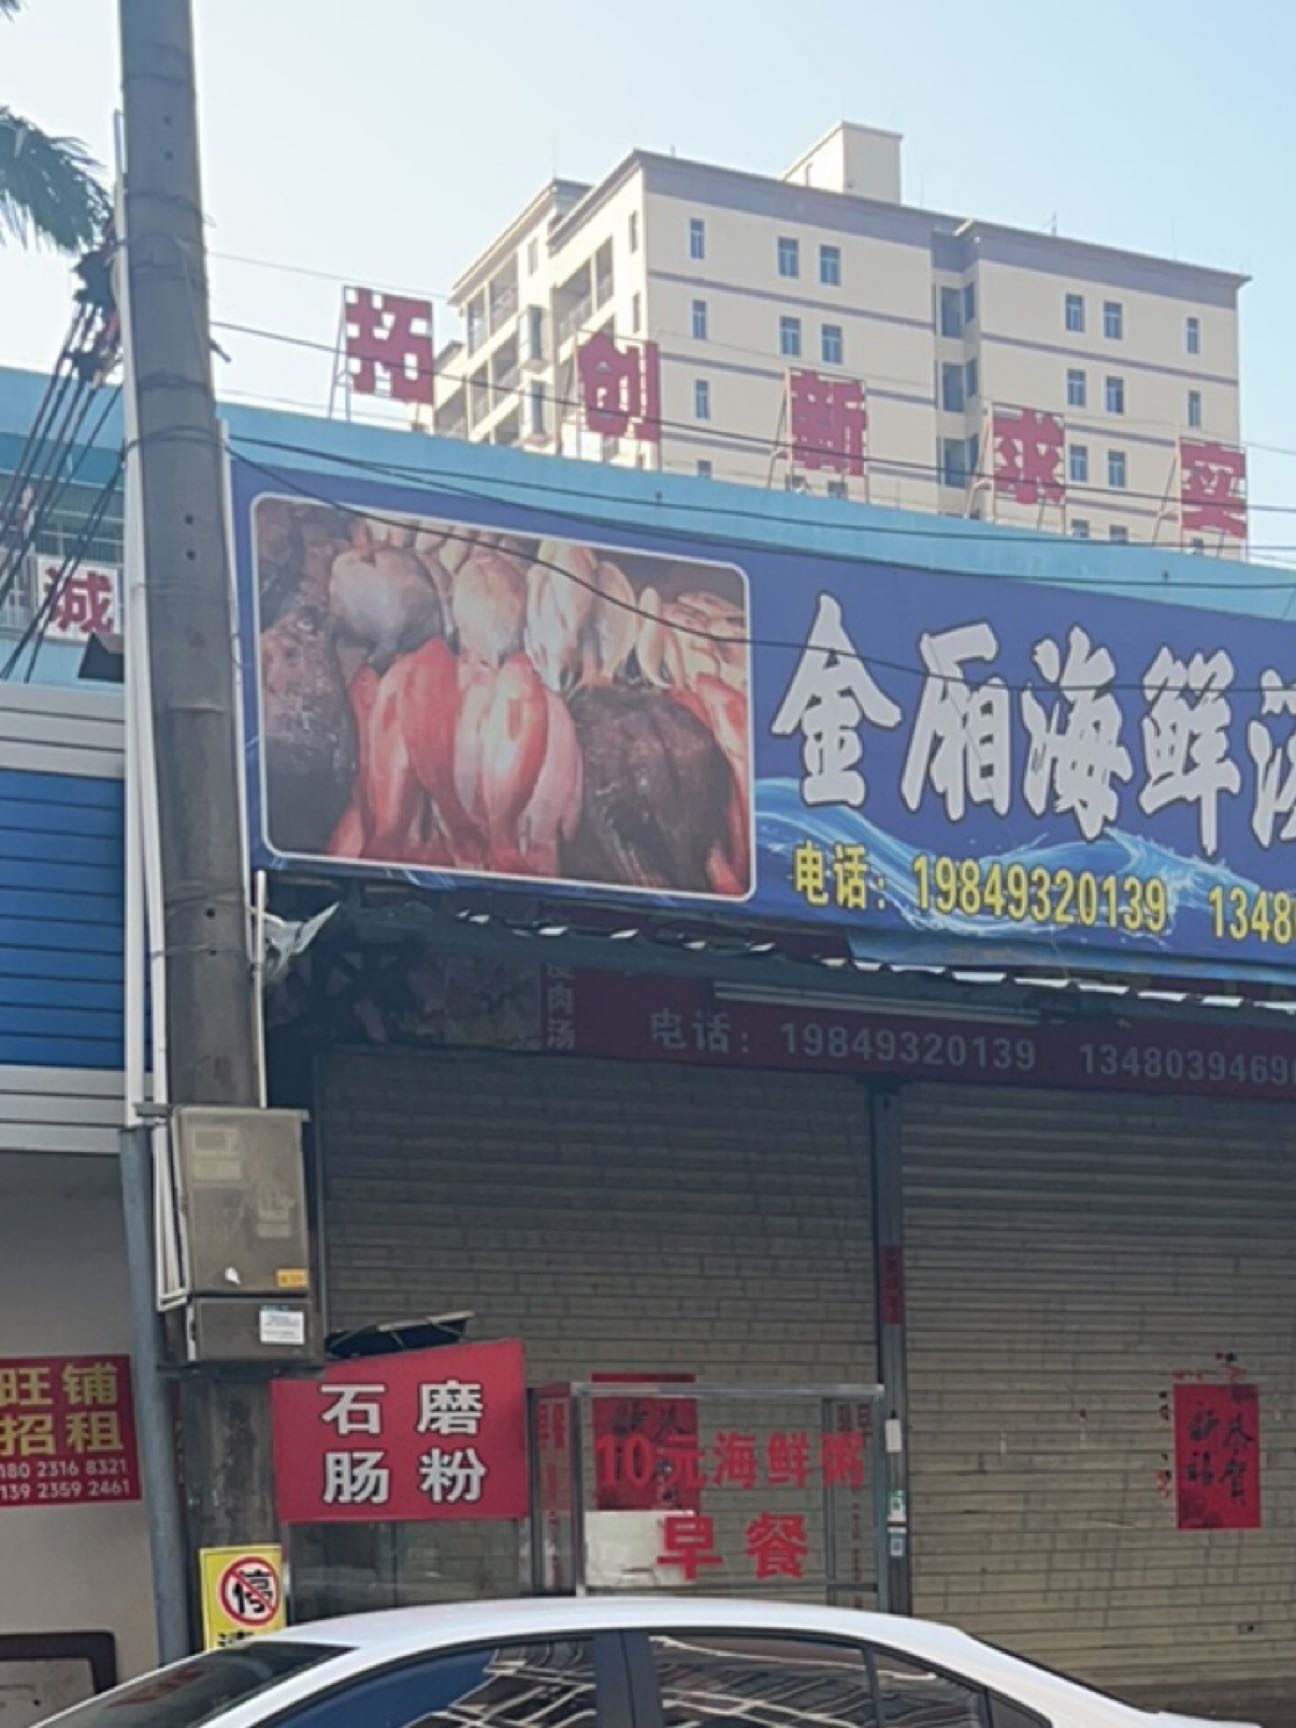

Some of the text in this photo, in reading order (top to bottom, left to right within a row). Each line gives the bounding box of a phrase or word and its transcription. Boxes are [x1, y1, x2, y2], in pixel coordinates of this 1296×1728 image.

[912, 853, 1169, 934] 19849320139
[780, 1021, 1037, 1072] 19849320139
[0, 1362, 118, 1406] 旺铺
[319, 1379, 484, 1436] 石磨
[0, 1411, 125, 1456] 招租
[322, 1447, 488, 1504] 肠粉
[657, 1513, 808, 1581] 早餐
